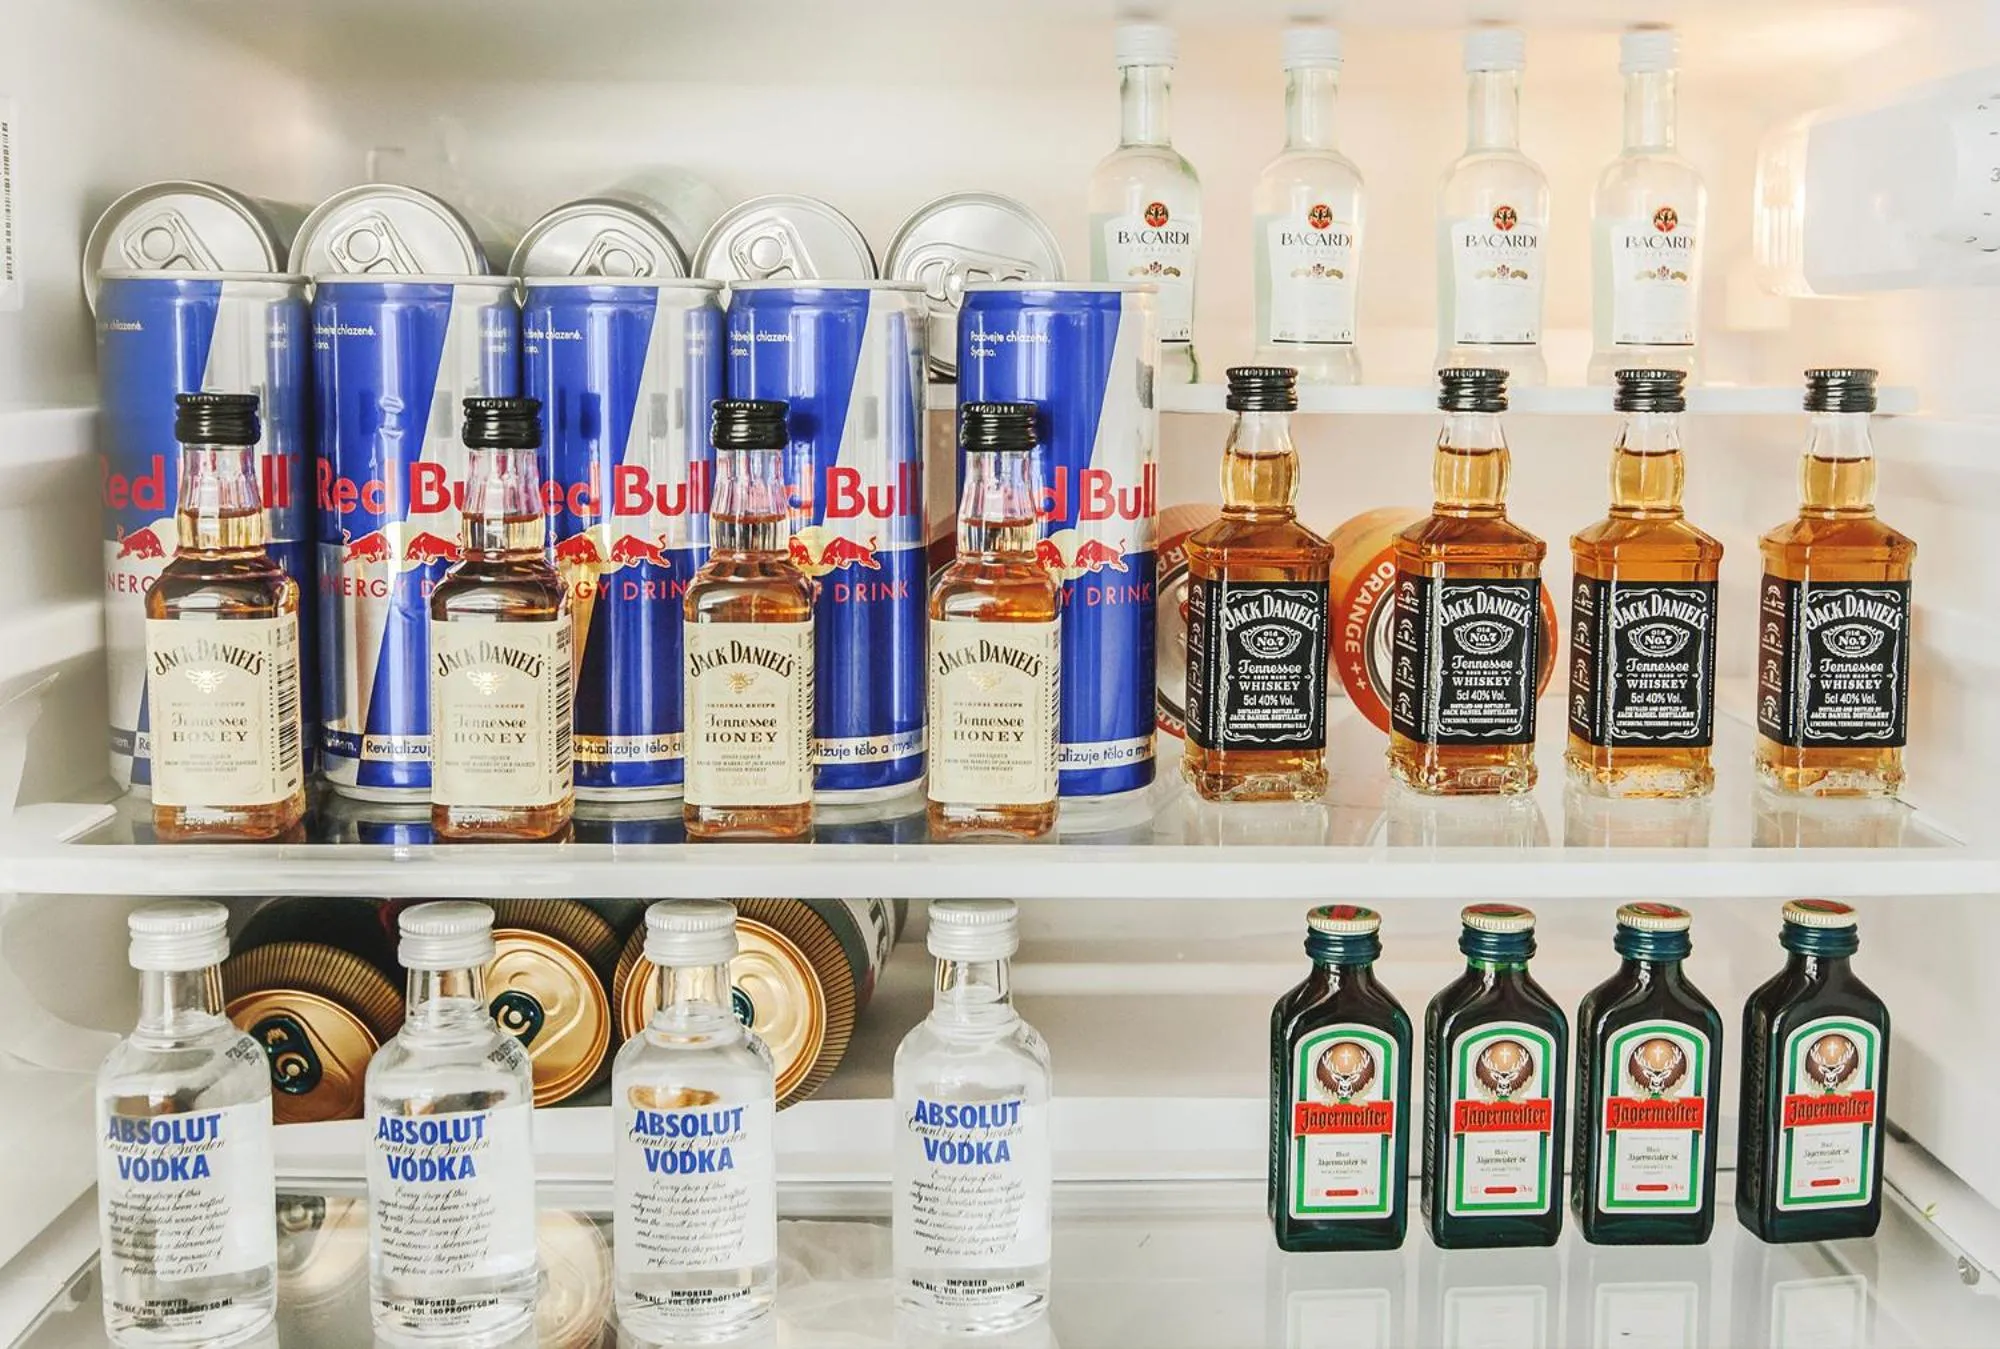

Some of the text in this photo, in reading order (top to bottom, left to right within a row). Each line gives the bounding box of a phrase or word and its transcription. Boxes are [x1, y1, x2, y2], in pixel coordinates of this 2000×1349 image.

[1118, 231, 1189, 245] BACARDI
[1466, 235, 1537, 248] BACARDI
[316, 456, 398, 516] Red
[540, 459, 710, 518] ed Bull
[826, 462, 918, 519] Bull
[1080, 463, 1158, 521] Bull
[623, 579, 688, 601] DRIN
[834, 579, 909, 603] DRINK
[1086, 582, 1150, 607] DRINK
[1221, 594, 1320, 631] JACK DANIEL'S
[1345, 561, 1396, 653] ORANGE
[1439, 591, 1532, 627] JACK DANIEL'S
[1613, 593, 1709, 630] JACK DANIEL'S
[1806, 593, 1903, 631] JACK DANIEL'S
[437, 639, 545, 679] JACK DANIEL'S
[689, 639, 796, 679] JACK DANIEL'S
[937, 639, 1044, 678] JACK DANIEL'S
[1238, 659, 1302, 674] Tennessee
[1452, 655, 1513, 670] Tennessee
[1625, 658, 1690, 673] Tennessee
[1819, 658, 1884, 673] Tennessee
[1239, 681, 1300, 691] WHISKEY
[1452, 677, 1512, 686] WHISKEY
[1626, 680, 1688, 689] WHISKEY
[1820, 680, 1883, 690] WHISKEY
[1243, 694, 1295, 706] 5cl 40% Vol.
[1456, 690, 1507, 701] 5cl 40% Vol.
[1631, 693, 1683, 704] 5cl 40% Vol.
[1824, 693, 1877, 705] 5cl 40% Vol.
[704, 713, 777, 728] Tennessee
[953, 711, 1025, 727] Tennessee
[705, 731, 778, 743] HONEY
[954, 730, 1025, 742] HONEY
[366, 740, 431, 757] Revitalizuj
[645, 738, 669, 753] tělo
[855, 741, 877, 756] tělo
[878, 745, 888, 753] a
[1103, 745, 1124, 760] tělo
[1126, 748, 1133, 757] a
[914, 1099, 1021, 1129] ABSOLUT
[108, 1113, 221, 1145] ABSOLUT
[378, 1114, 486, 1145] ABSOLUT
[634, 1107, 744, 1138] ABSOLUT
[628, 1127, 677, 1154] Country
[680, 1138, 695, 1155] of
[923, 1137, 1012, 1165] VODKA
[117, 1154, 211, 1182] VODKA
[386, 1154, 476, 1182] VODKA
[644, 1147, 734, 1175] VODKA
[946, 1279, 988, 1287] IMPORTED
[671, 1289, 713, 1298] IMPORTED
[145, 1298, 189, 1307] IMPORTED
[413, 1299, 457, 1307] IMPORTED
